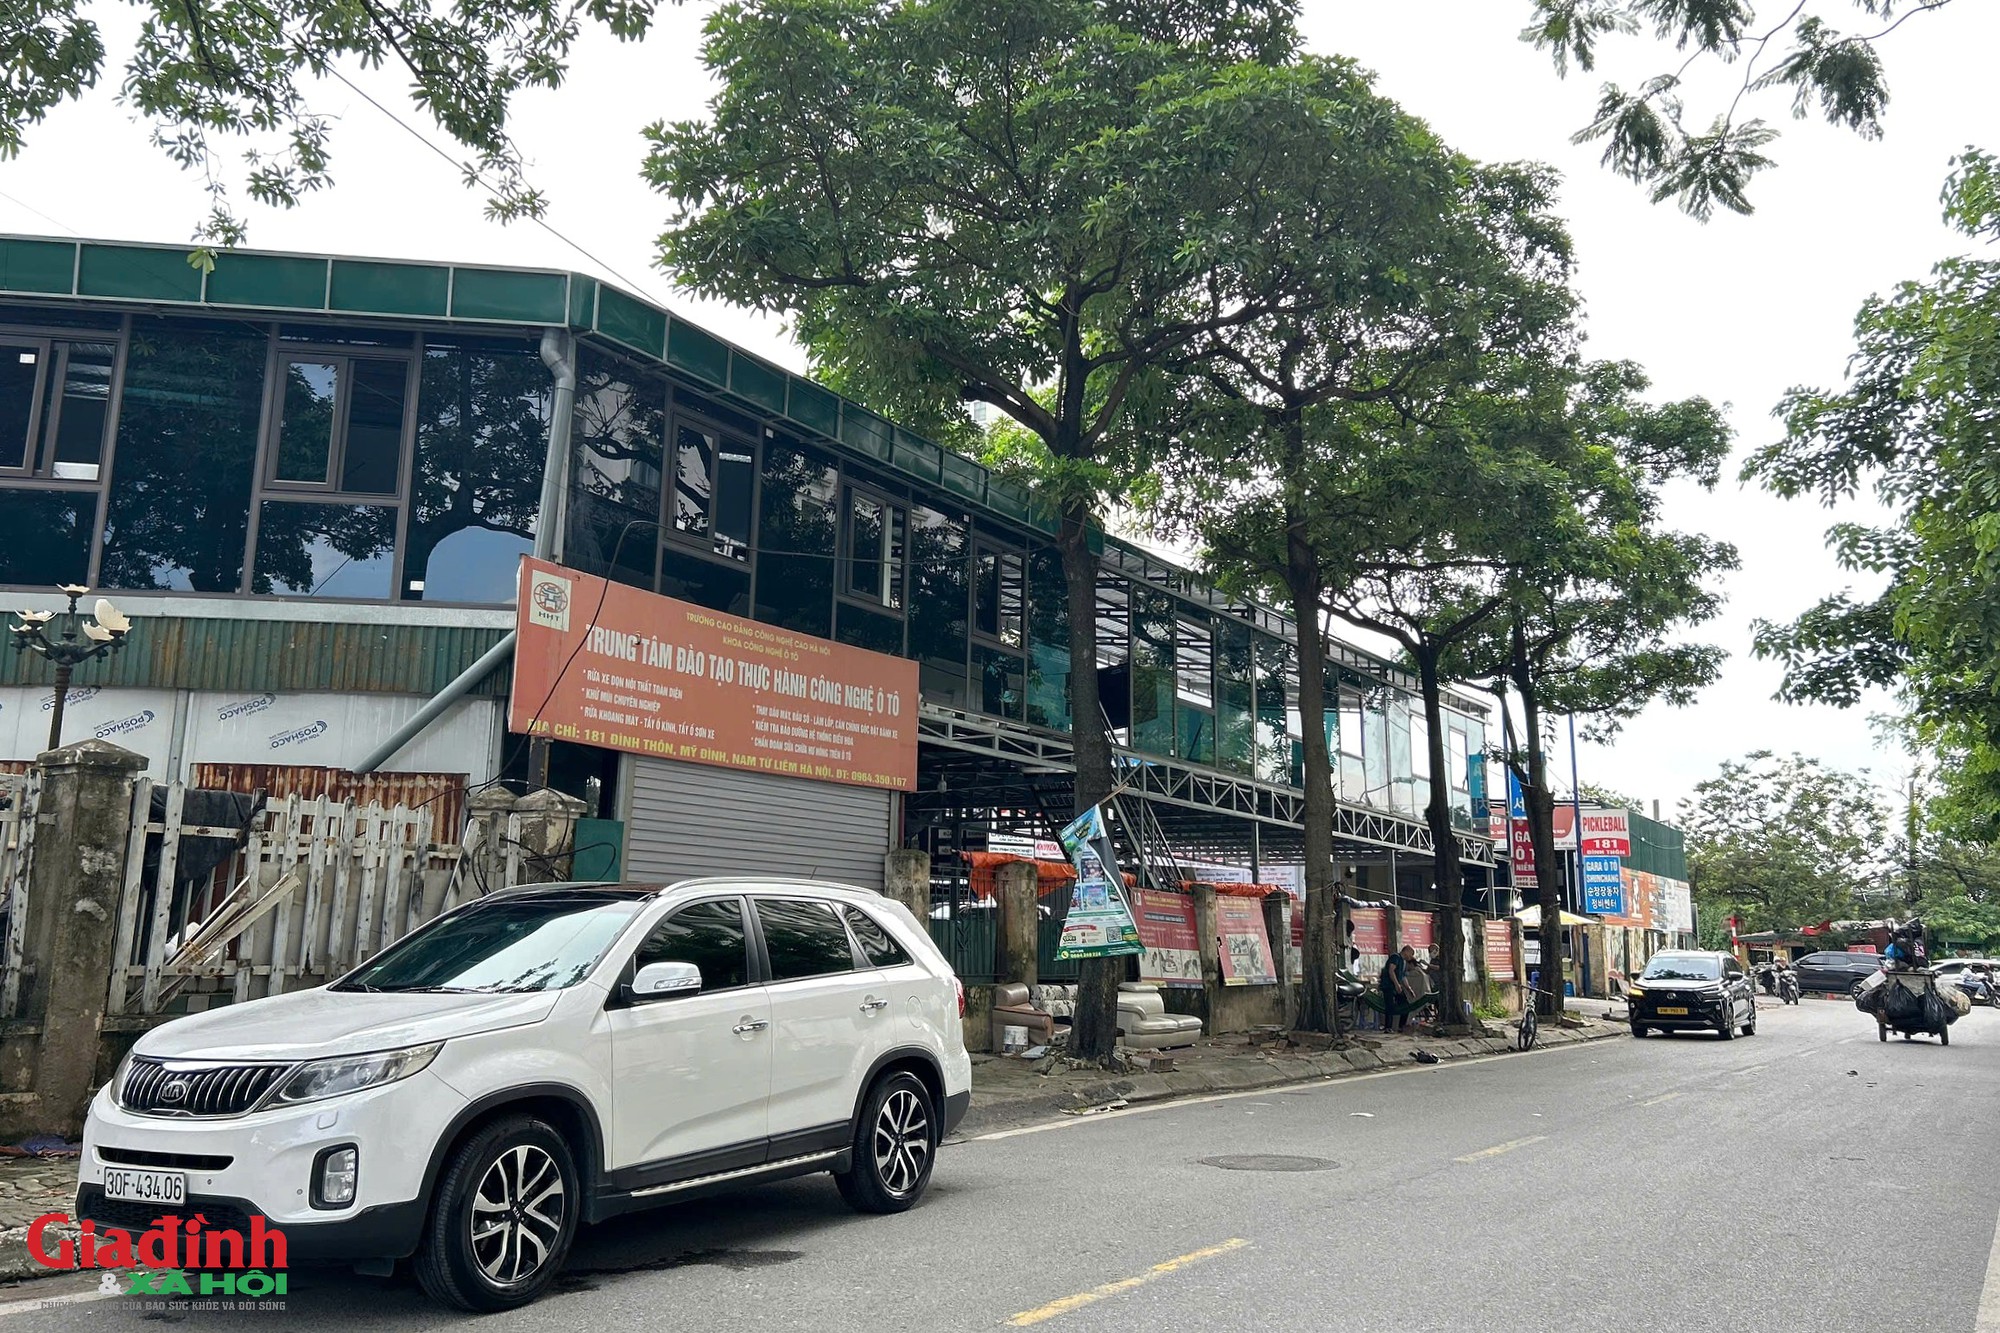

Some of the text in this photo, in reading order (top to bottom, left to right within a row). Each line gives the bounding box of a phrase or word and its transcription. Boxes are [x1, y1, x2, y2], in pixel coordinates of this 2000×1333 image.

[538, 611, 560, 622] HHT
[686, 611, 715, 627] TRƯỜNG
[716, 621, 733, 632] CAO
[754, 629, 775, 642] CÔNG
[776, 636, 794, 648] NGHỆ
[794, 640, 809, 651] CAO
[810, 641, 819, 653] HÀ
[819, 645, 831, 656] NỘI
[722, 636, 743, 649] KHOA
[743, 639, 765, 653] CÔNG
[783, 649, 790, 660] Ô
[790, 651, 799, 661] TÔ
[585, 623, 900, 717] TRUNG TÂM ĐÀO TẠO THỰC HÀNH CÔNG NGHỆ Ô TÔ
[586, 667, 601, 682] RỬA
[601, 673, 610, 685] XE
[625, 677, 636, 692] NỘI
[637, 678, 652, 693] THẤT
[42, 686, 92, 711] POSHCO
[219, 697, 267, 721] POSHACO
[585, 687, 600, 700] KHỬ
[600, 690, 613, 703] MÙI
[613, 692, 638, 709] CHUYÊN
[95, 714, 146, 739] POSHACO
[584, 703, 598, 719] RỬA
[598, 707, 625, 724] KHOANG
[625, 713, 640, 726] MÁY
[694, 725, 707, 739] SƠN
[707, 728, 715, 740] XE
[769, 721, 780, 733] TRA
[271, 724, 319, 749] POSHACO
[891, 729, 898, 740] XE
[527, 718, 550, 735] ĐỊA
[554, 722, 581, 739] CHỈ:
[584, 728, 606, 743] 181
[610, 733, 640, 750] ĐÌNH
[680, 743, 698, 758] MỸ
[732, 753, 757, 767] NAM
[759, 755, 772, 769] TỪ
[773, 758, 798, 774] LIÊM
[800, 762, 813, 776] HÀ
[851, 771, 907, 787] 0964.350.167
[1583, 816, 1627, 832] PICKLEBALL
[1515, 830, 1532, 843] GA
[1593, 839, 1618, 849] 181
[1515, 846, 1525, 861] Ô
[1586, 859, 1618, 872] GARA Ô TÔ
[161, 1083, 180, 1098] KIA
[106, 1171, 183, 1201] 30F-434.06
